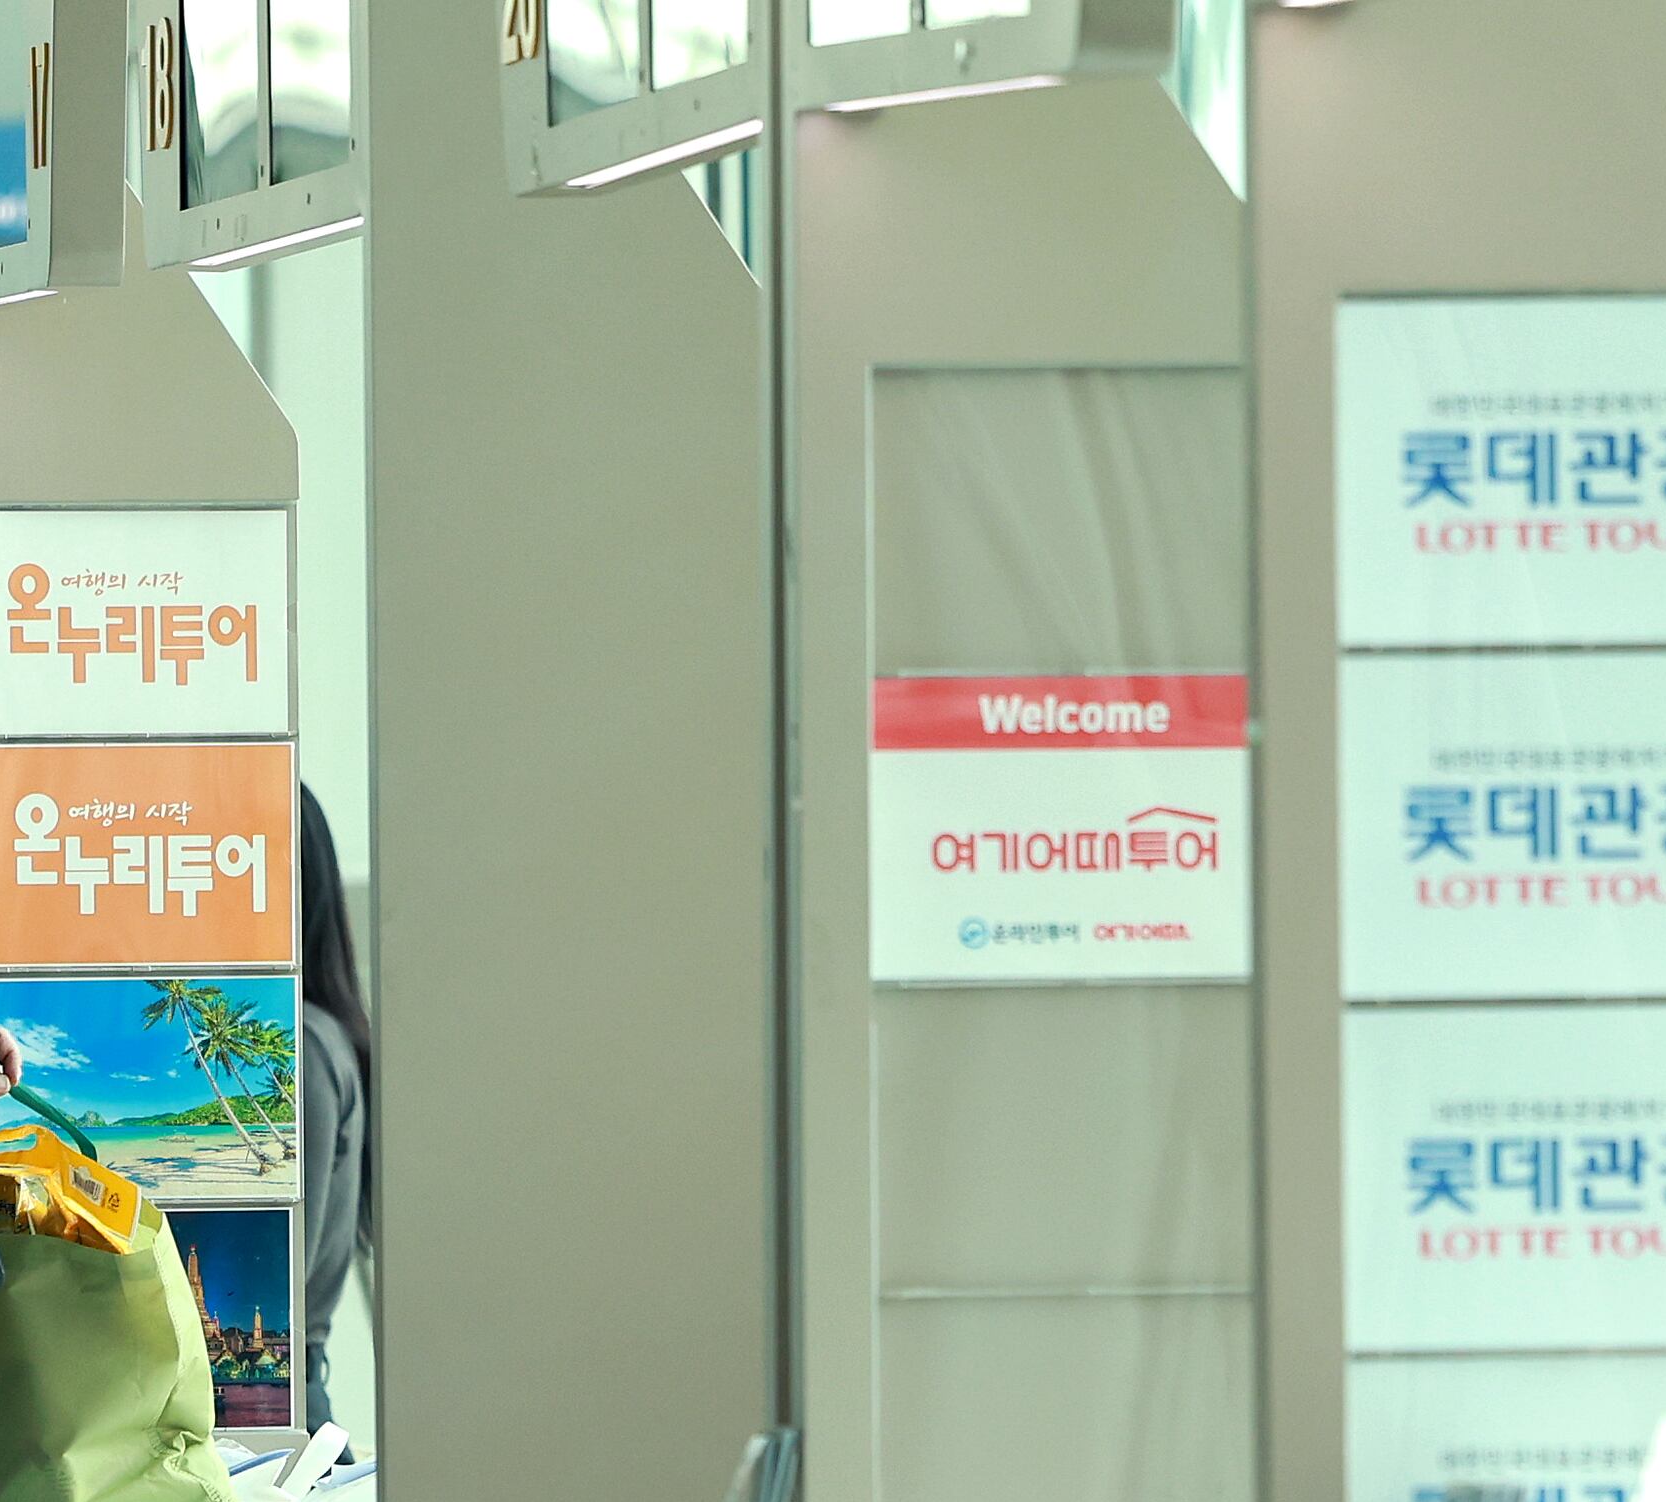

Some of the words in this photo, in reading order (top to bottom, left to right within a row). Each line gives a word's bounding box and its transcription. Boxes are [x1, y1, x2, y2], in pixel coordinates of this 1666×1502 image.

[141, 16, 175, 152] 18
[30, 42, 50, 170] 17
[1415, 519, 1568, 554] LOTTE
[61, 568, 127, 597] 여행의
[137, 571, 184, 596] 시작
[7, 563, 258, 686] 온누리투어
[978, 694, 1170, 734] Welcome
[68, 798, 135, 827] 여행의
[145, 800, 193, 827] 시작
[14, 792, 267, 917] 온누리투어
[933, 826, 1219, 873] 여기어때투어
[1416, 872, 1569, 908] LOTTE
[1419, 1226, 1569, 1262] LOTTE
